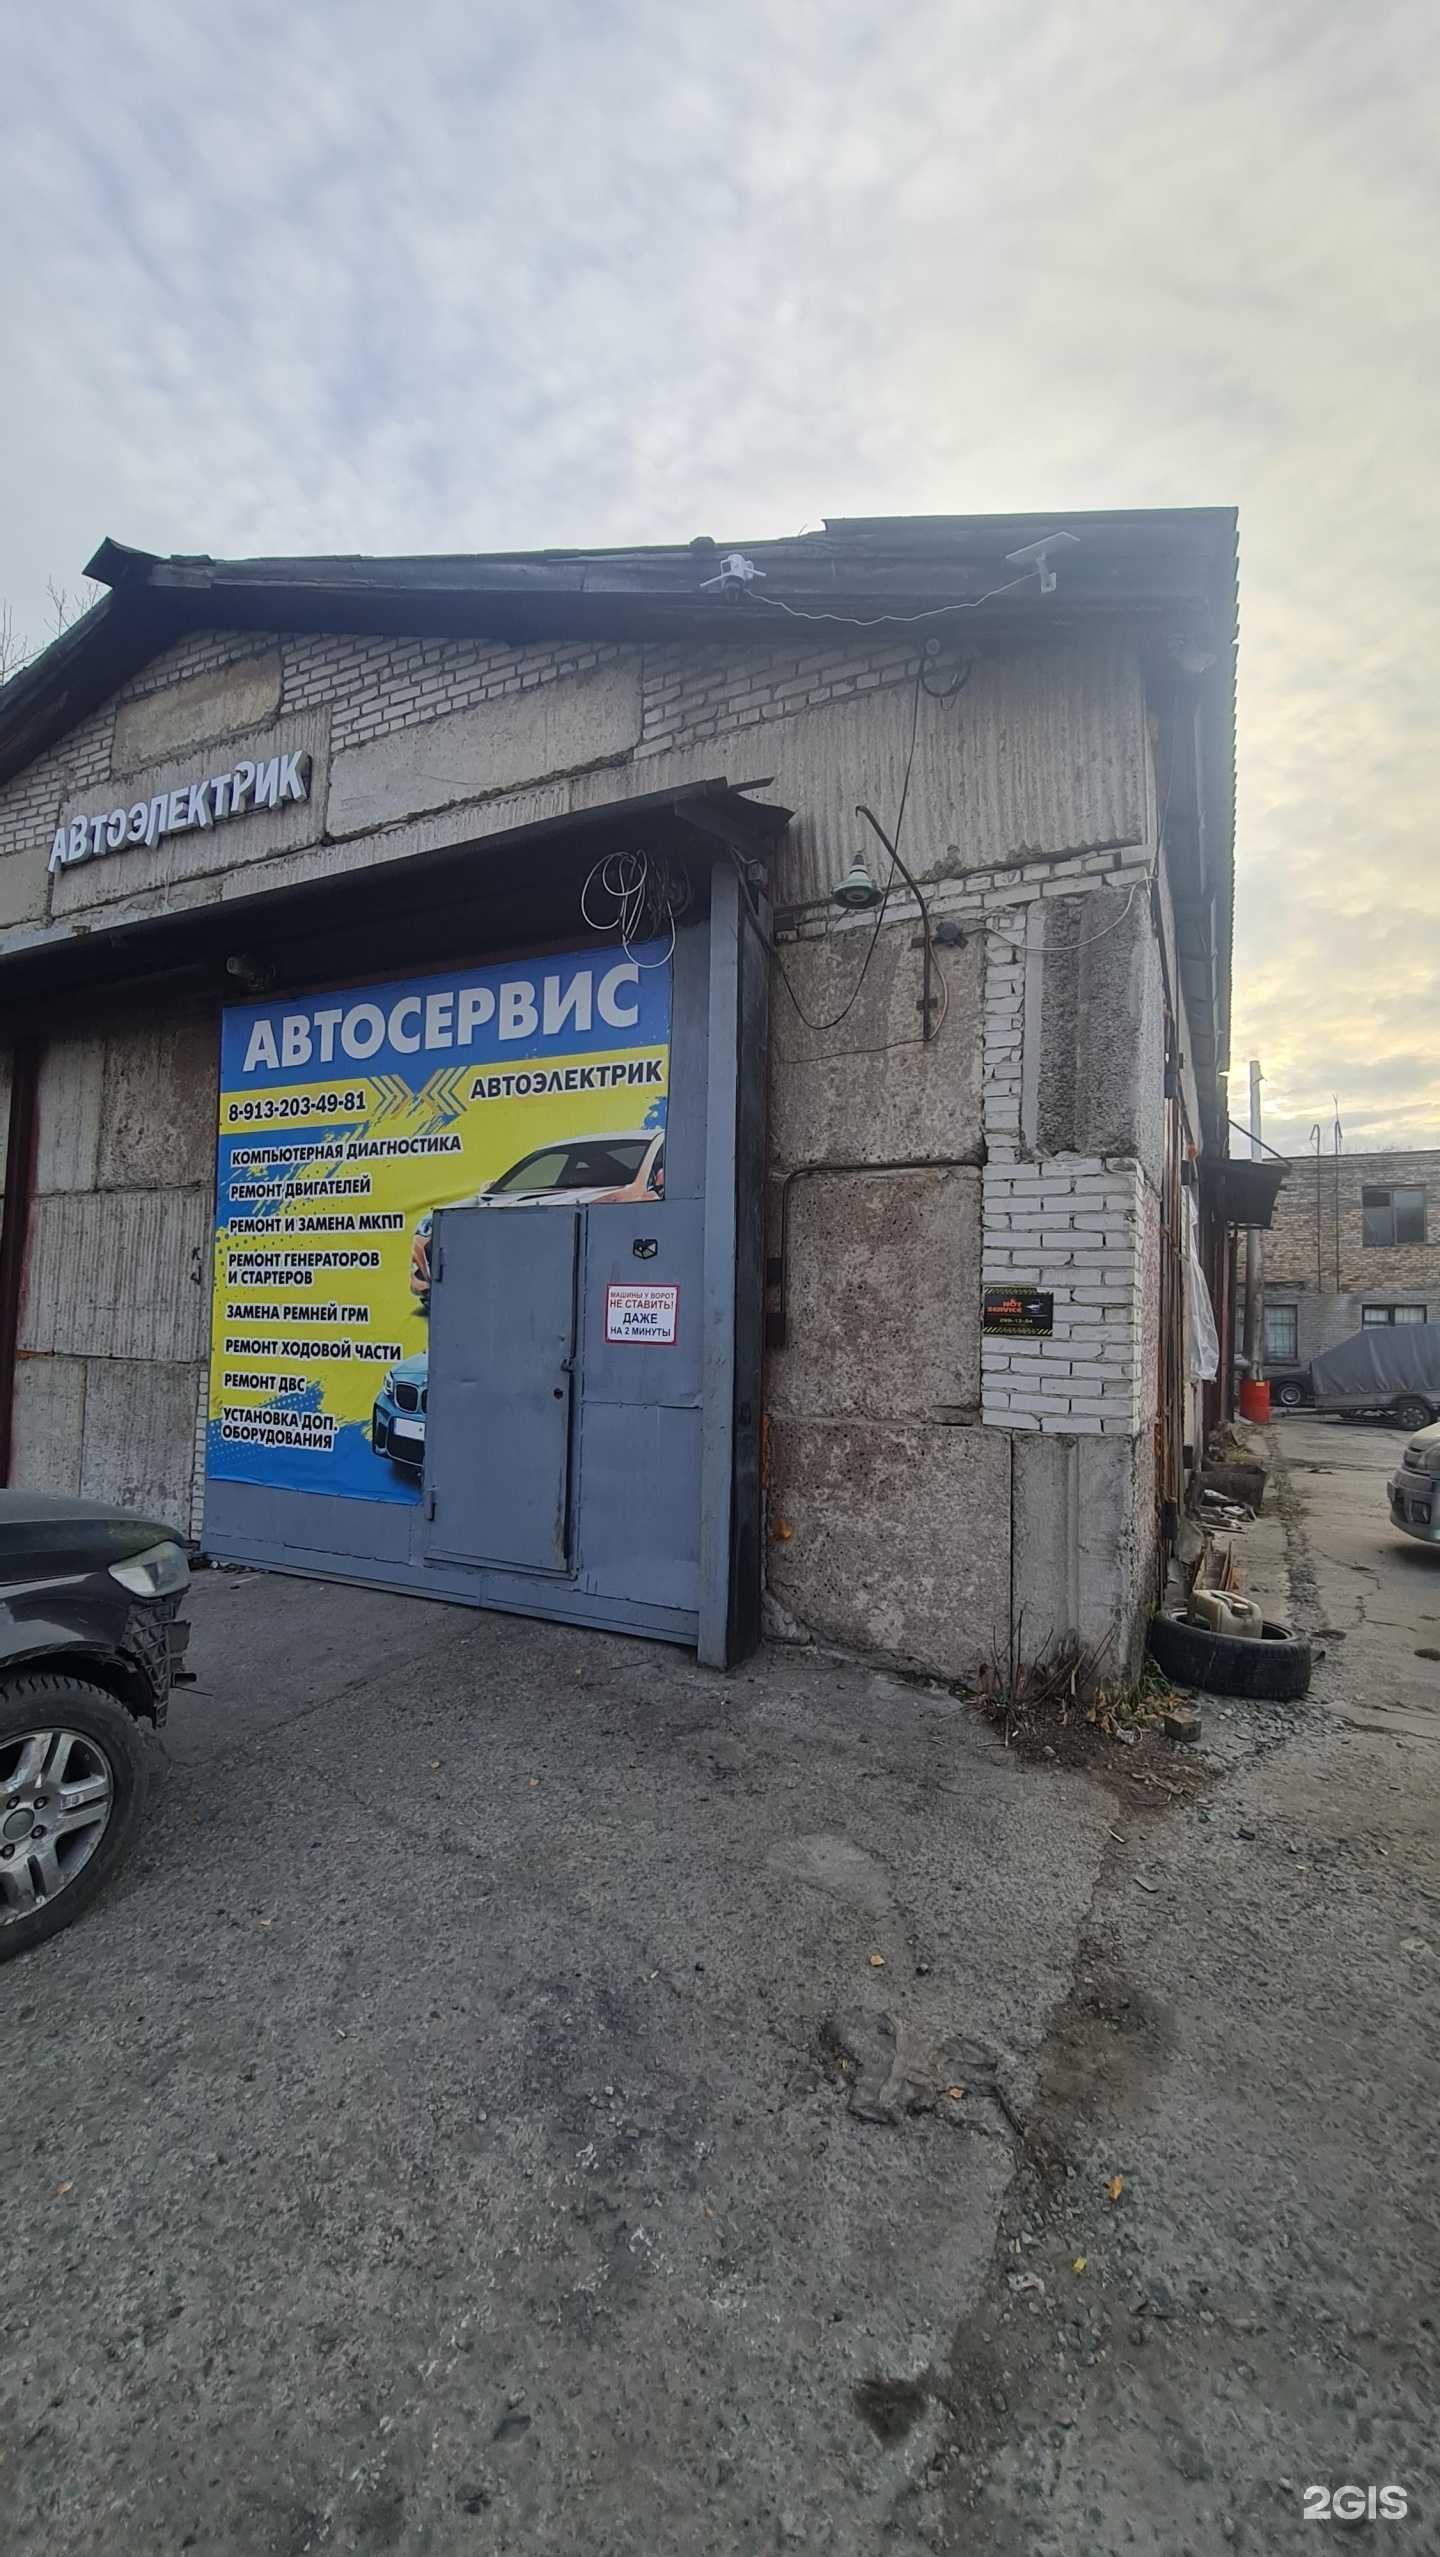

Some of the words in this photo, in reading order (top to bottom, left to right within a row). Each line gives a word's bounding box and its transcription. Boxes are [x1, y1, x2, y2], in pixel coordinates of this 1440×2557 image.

[48, 751, 309, 872] АВТОЭЛЕКТРИК
[242, 963, 639, 1071] АВТОСЕРВИС
[471, 1059, 663, 1100] АВТОЭЛЕКТРИК
[229, 1091, 366, 1122] 8-913-203-49-81
[232, 1144, 343, 1165] КОМПЬЮТЕРНАЯ
[346, 1135, 461, 1160] ДИАГНОСТИКА
[231, 1183, 283, 1200] РЕМОНТ
[285, 1176, 371, 1200] ДВИГАТЕЛЕЙ
[230, 1217, 282, 1234] РЕМОНТ
[285, 1217, 295, 1232] И
[299, 1216, 355, 1231] ЗАМЕНА
[359, 1214, 403, 1230] МКПП
[229, 1253, 281, 1267] РЕМОНТ
[284, 1252, 379, 1267] ГЕНЕРАТОРОВ
[228, 1270, 238, 1284] И
[241, 1270, 312, 1285] СТАРТЕРОВ
[227, 1304, 280, 1320] ЗАМЕНА
[283, 1303, 338, 1321] РЕМНЕЙ
[341, 1307, 369, 1322] ГРМ
[609, 1299, 622, 1308] НЕ
[625, 1299, 674, 1309] СТАВИТЬ!
[623, 1312, 658, 1325] ДАЖЕ
[610, 1327, 622, 1335] НА
[625, 1327, 630, 1335] 2
[632, 1327, 671, 1337] МИНУТЫ
[226, 1339, 278, 1355] РЕМОНТ
[281, 1340, 351, 1359] ХОДОВОЙ
[355, 1344, 401, 1361] ЧАСТИ
[224, 1373, 276, 1390] РЕМОНТ
[279, 1376, 306, 1393] ДВС
[223, 1407, 298, 1428] УСТАНОВКА
[302, 1414, 338, 1432] ДОП.
[222, 1425, 333, 1449] ОБОРУДОВАНИЯ
